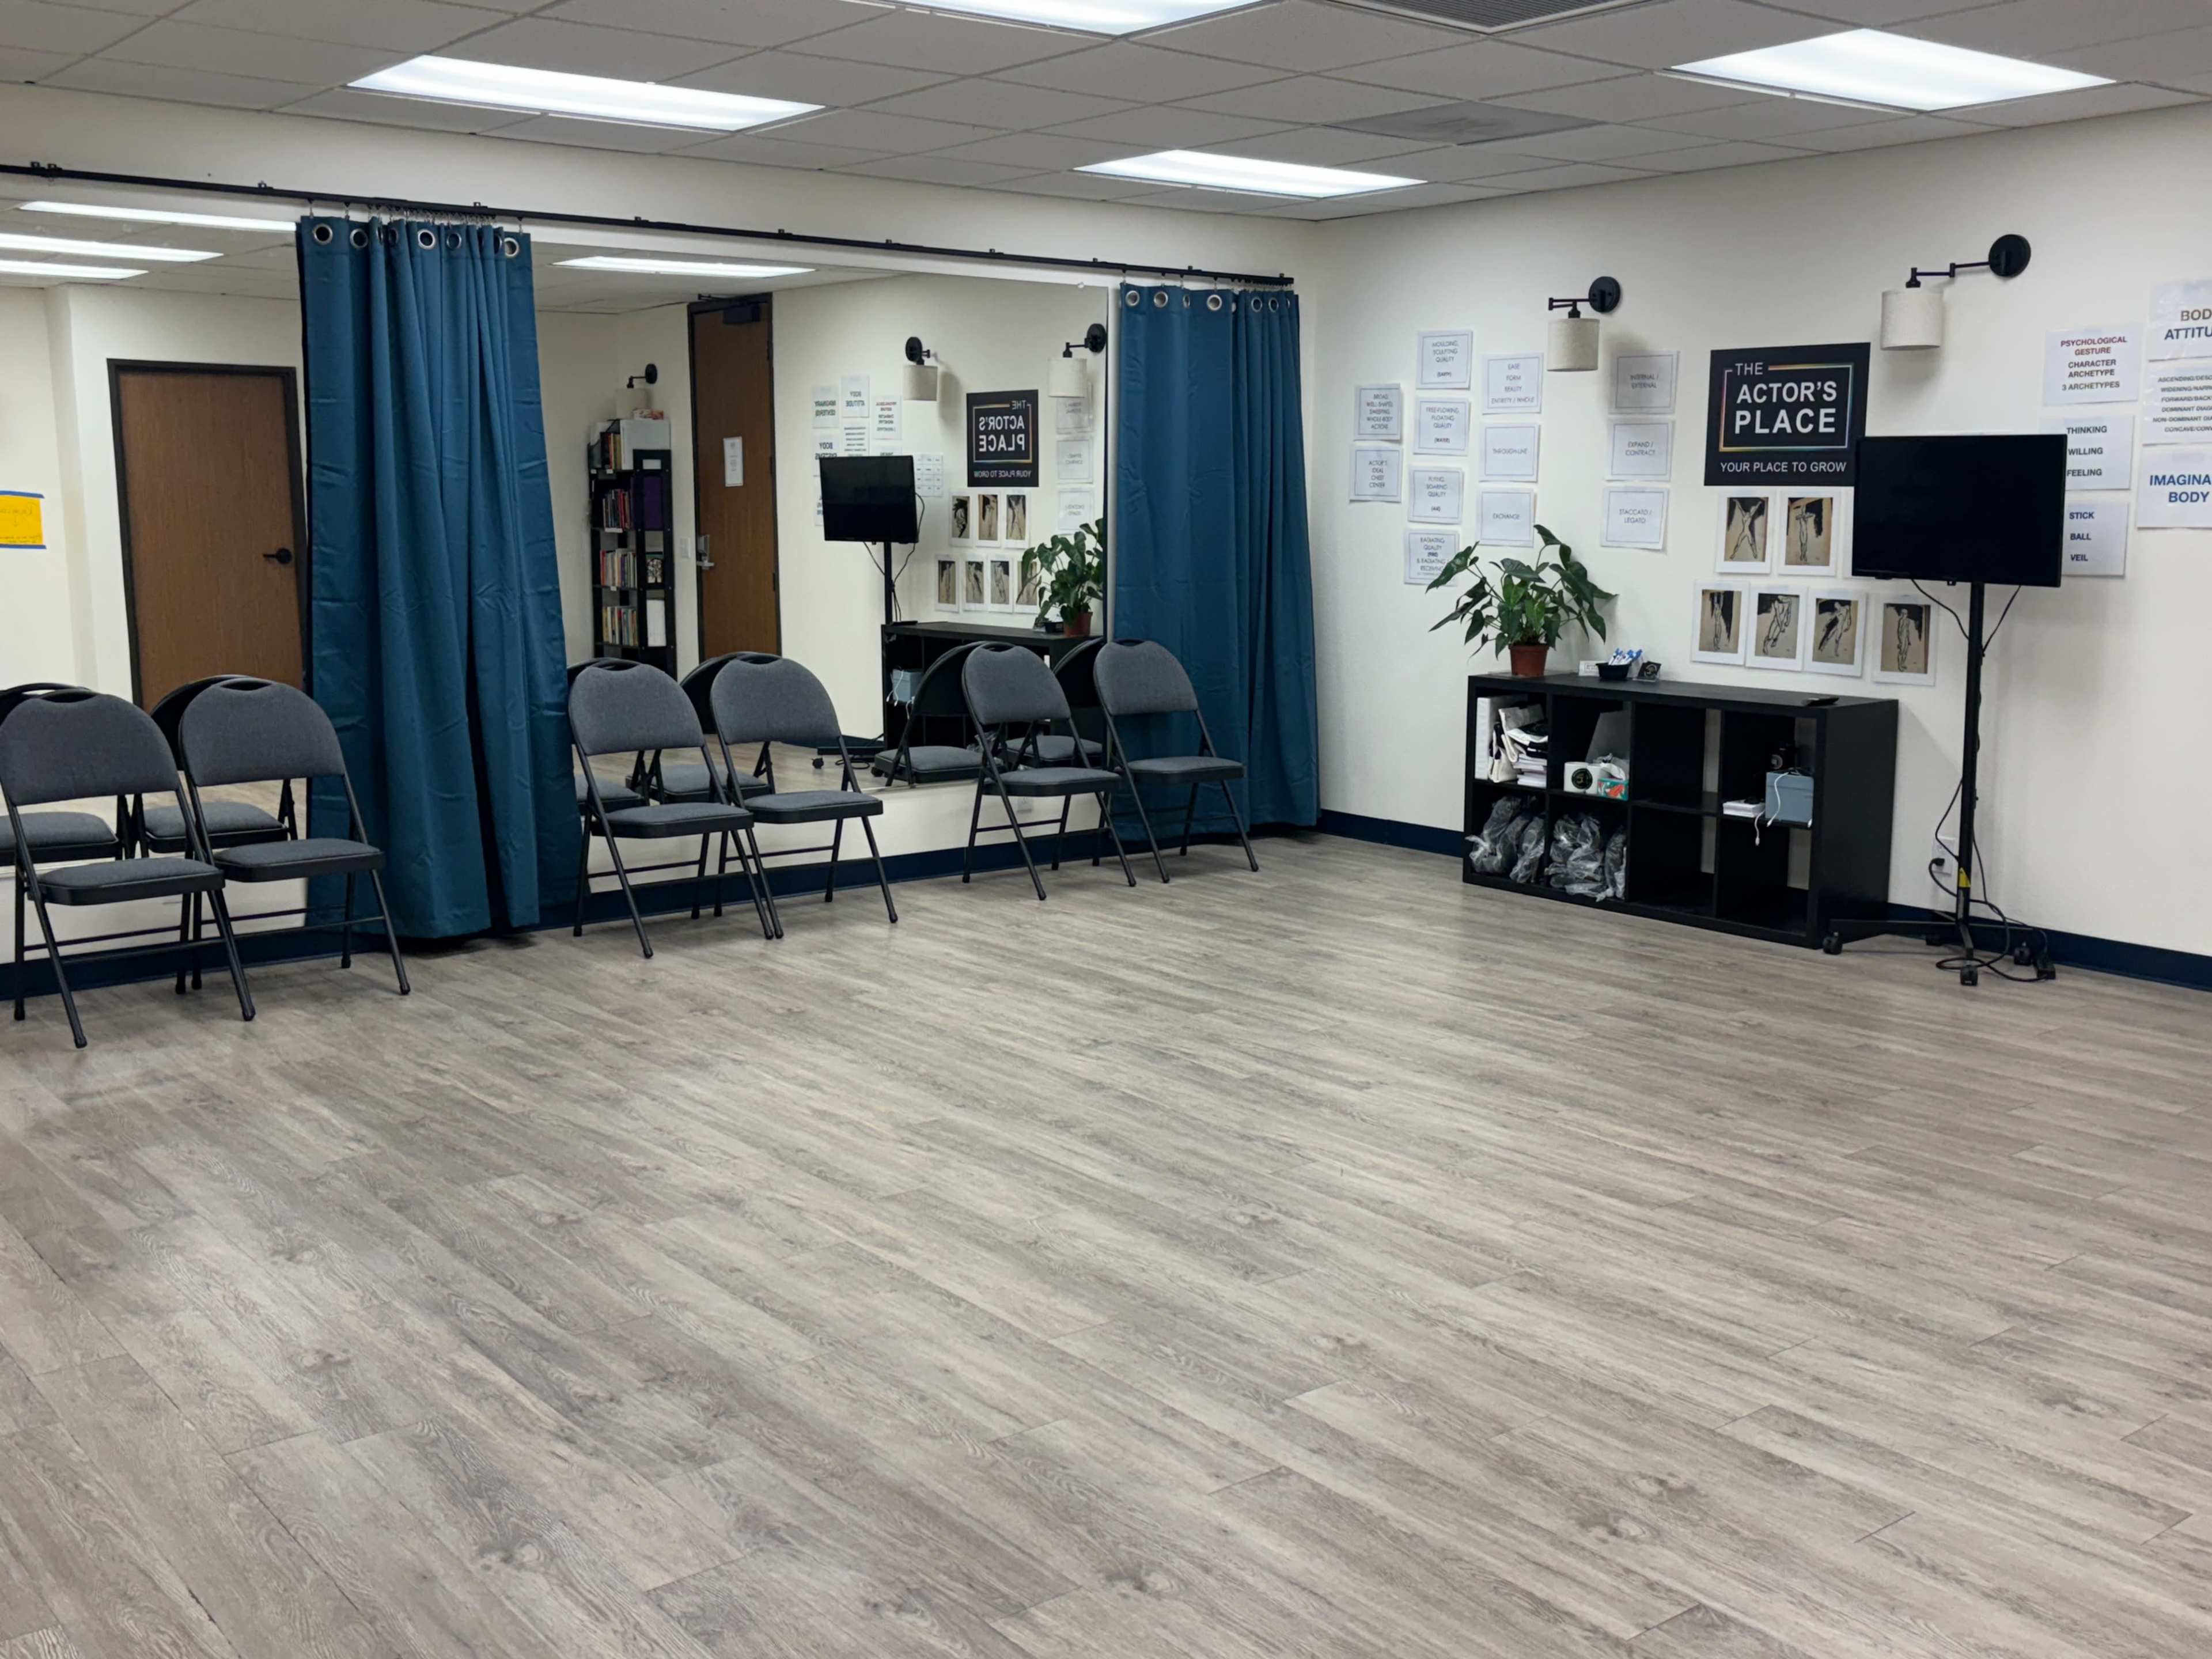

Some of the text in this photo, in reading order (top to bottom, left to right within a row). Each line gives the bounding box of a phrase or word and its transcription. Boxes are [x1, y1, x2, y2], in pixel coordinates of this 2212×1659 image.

[2061, 336, 2127, 347] PSYCHOLOGICAL
[2074, 347, 2111, 356] GESTURE
[2068, 359, 2116, 369] CHARACTER
[1734, 362, 1763, 376] THE
[2068, 369, 2115, 378] ARCHETYPE
[2068, 381, 2120, 391] ARCHETYPES
[1736, 381, 1837, 404] ACTOR'S
[1735, 408, 1836, 434] PLACE
[2066, 426, 2107, 434] THINKING
[2068, 447, 2103, 456] WILLING
[1720, 461, 1846, 472] YOUR PLACE TO GROW
[2067, 469, 2102, 477] FEELING
[2169, 491, 2210, 503] BODY
[2069, 512, 2094, 520] STICK
[2070, 533, 2092, 541] BALL
[2070, 554, 2088, 562] VEIL
